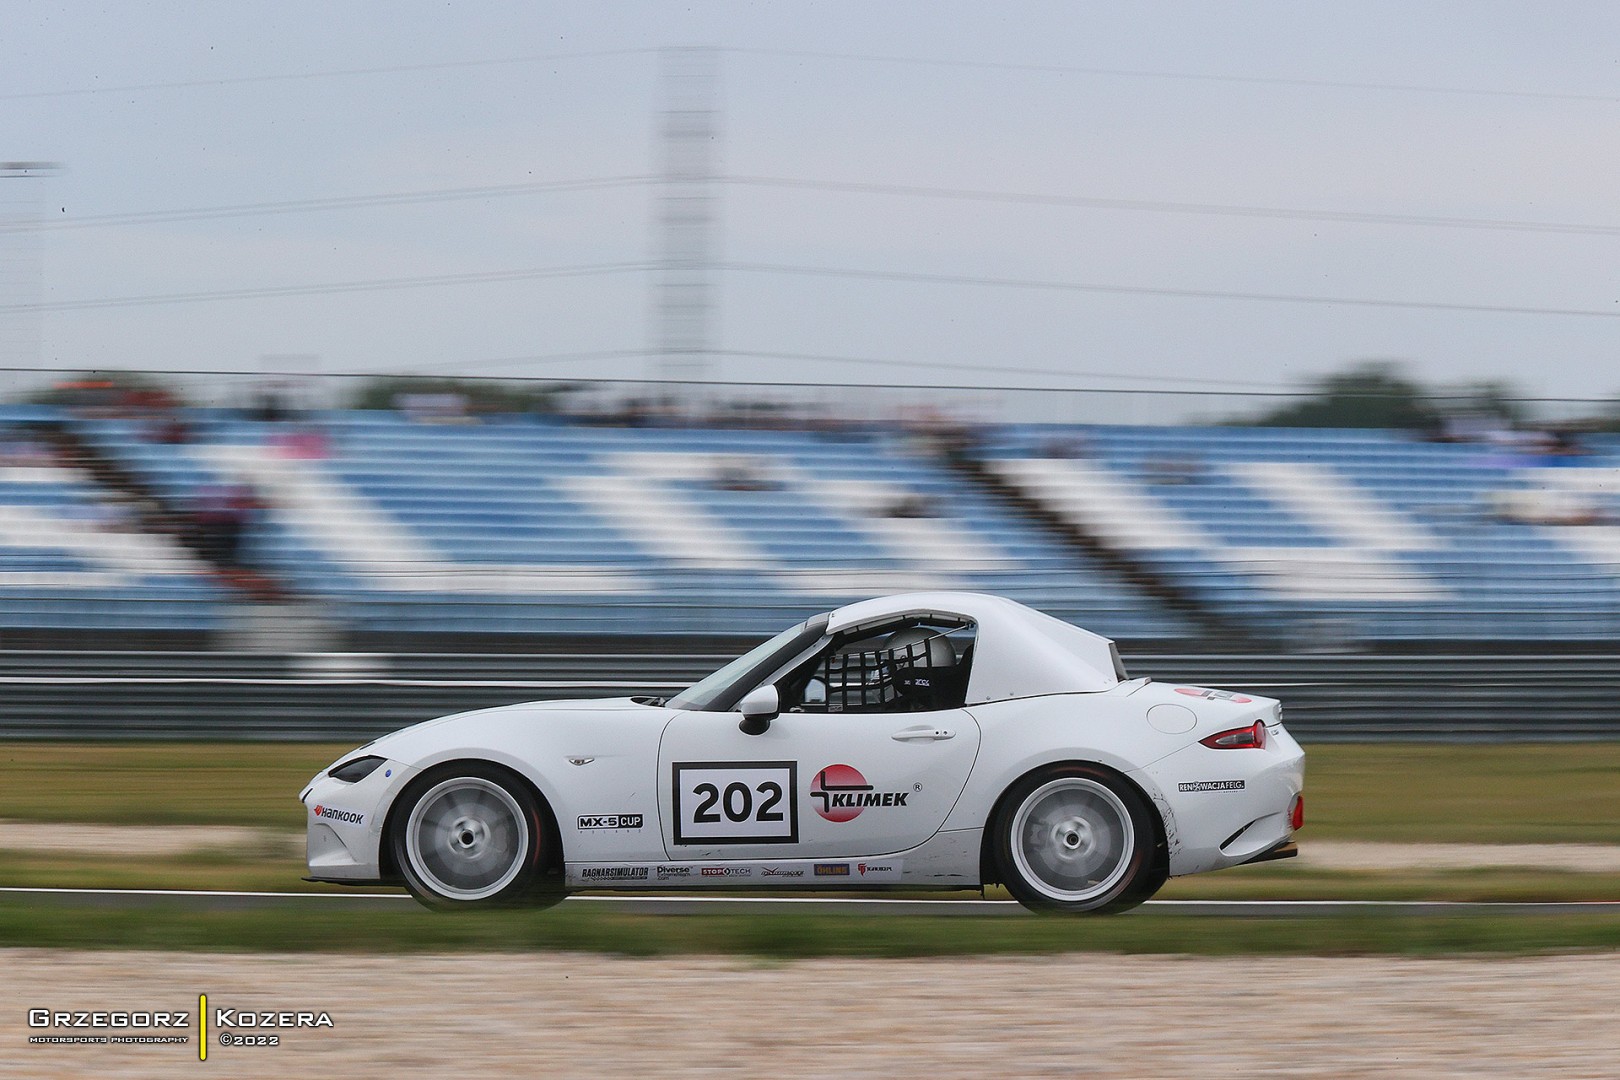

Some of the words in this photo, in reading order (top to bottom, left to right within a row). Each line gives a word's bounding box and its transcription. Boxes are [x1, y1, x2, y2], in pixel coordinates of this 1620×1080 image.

[692, 781, 784, 824] 202
[831, 792, 910, 808] KLIMEK
[580, 817, 618, 827] MX-5
[620, 816, 641, 826] CUP
[582, 867, 648, 878] RAGNARSIMULATOR
[657, 866, 690, 874] Diverse
